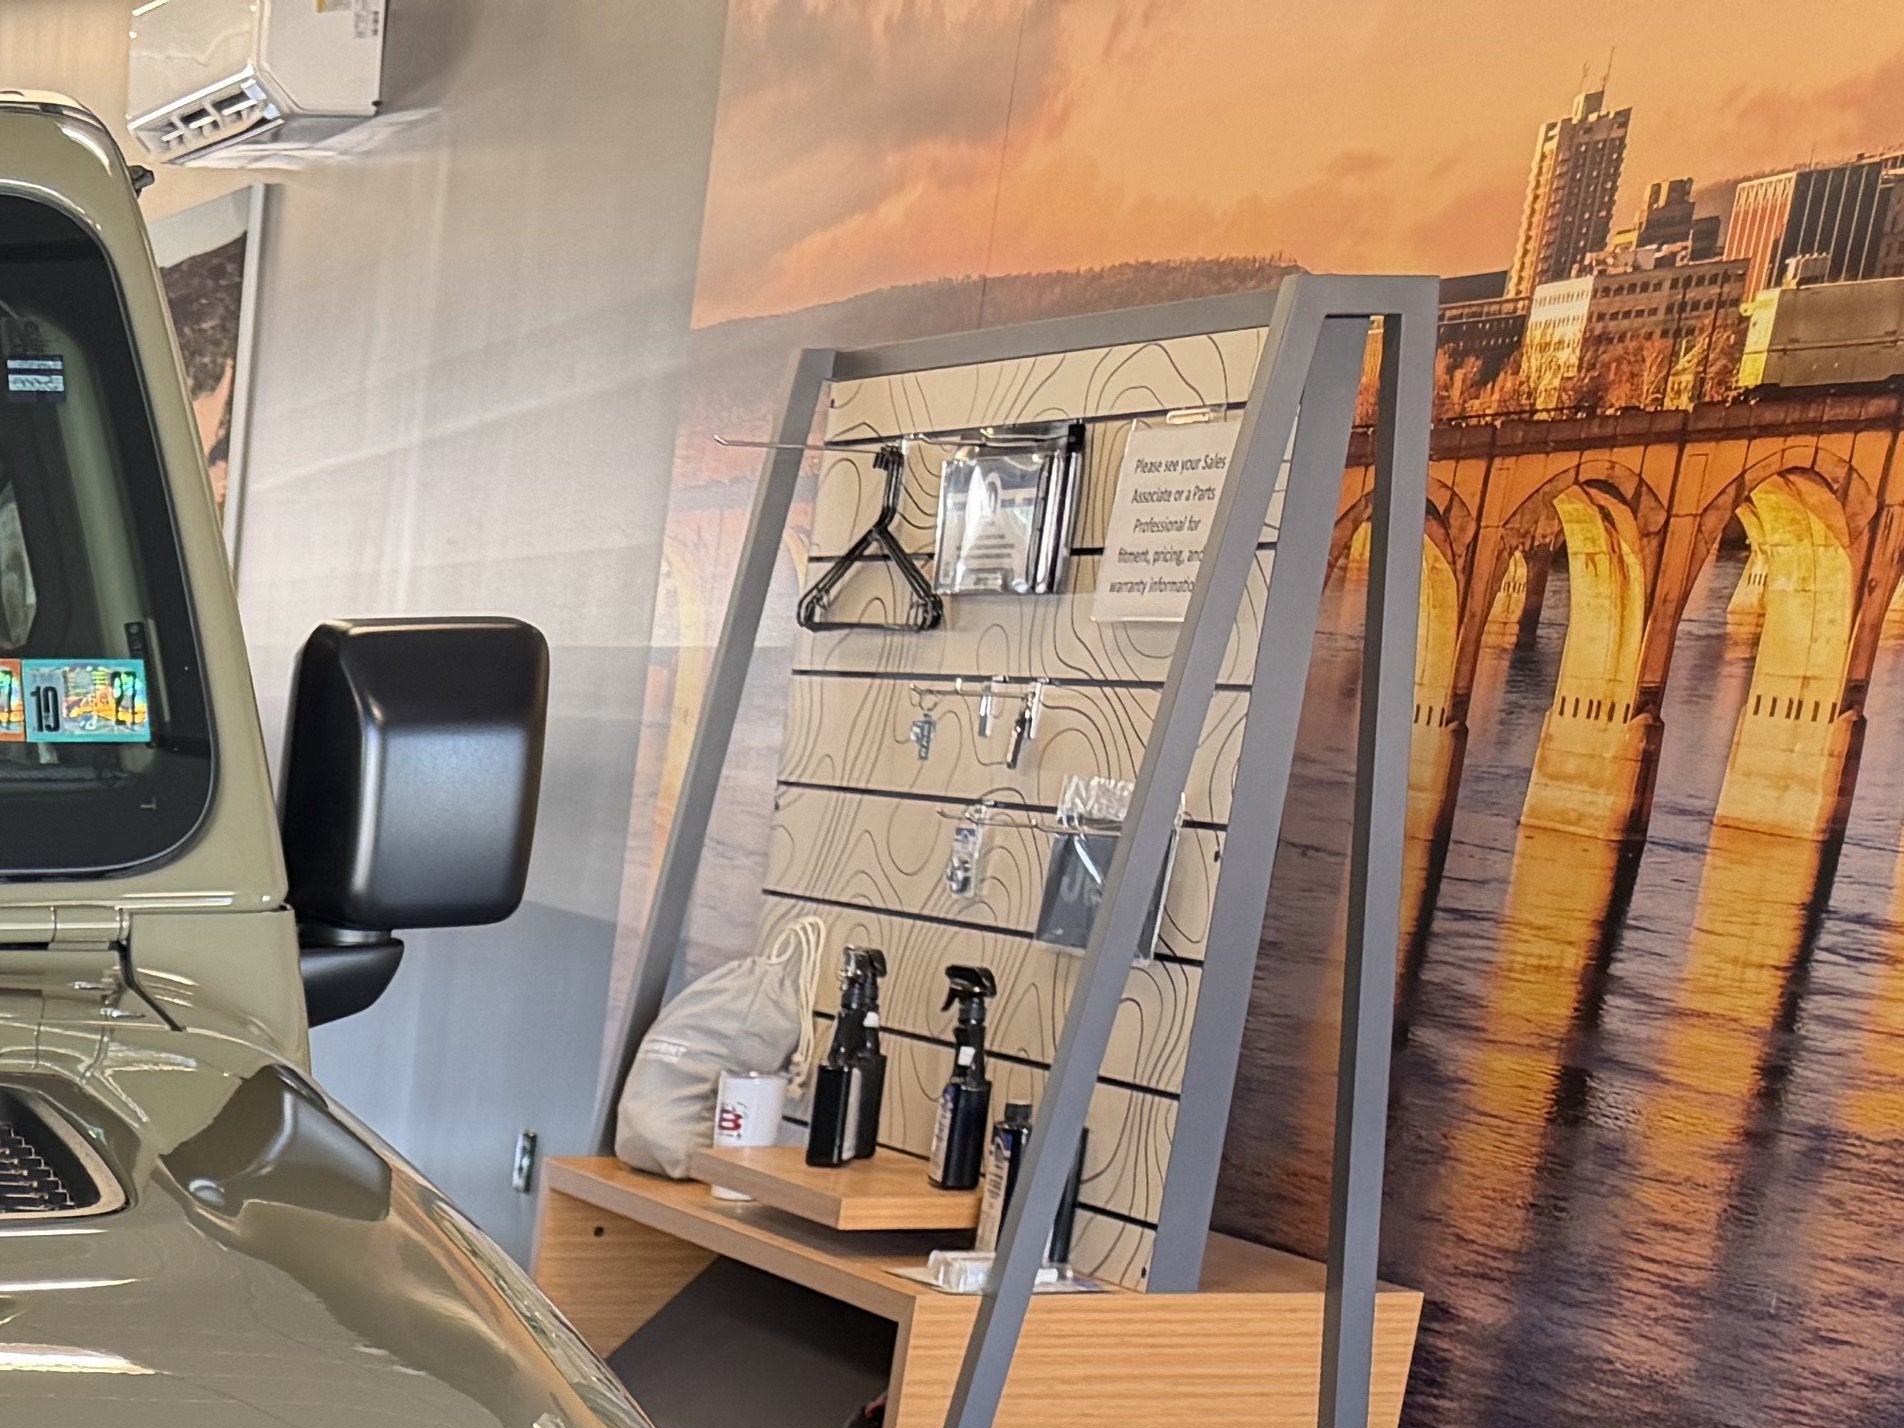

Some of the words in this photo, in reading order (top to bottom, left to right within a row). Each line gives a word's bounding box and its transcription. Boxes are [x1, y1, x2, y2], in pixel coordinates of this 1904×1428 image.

[1134, 457, 1162, 474] Please
[1164, 460, 1179, 473] see
[1180, 458, 1202, 475] your
[1201, 452, 1228, 470] Sales
[1130, 487, 1172, 504] Associate
[1173, 491, 1185, 502] or
[1191, 485, 1217, 501] Parts
[1133, 515, 1187, 534] Professional
[1186, 515, 1202, 532] for
[1109, 578, 1148, 596] warranty
[1148, 576, 1196, 593] informatio
